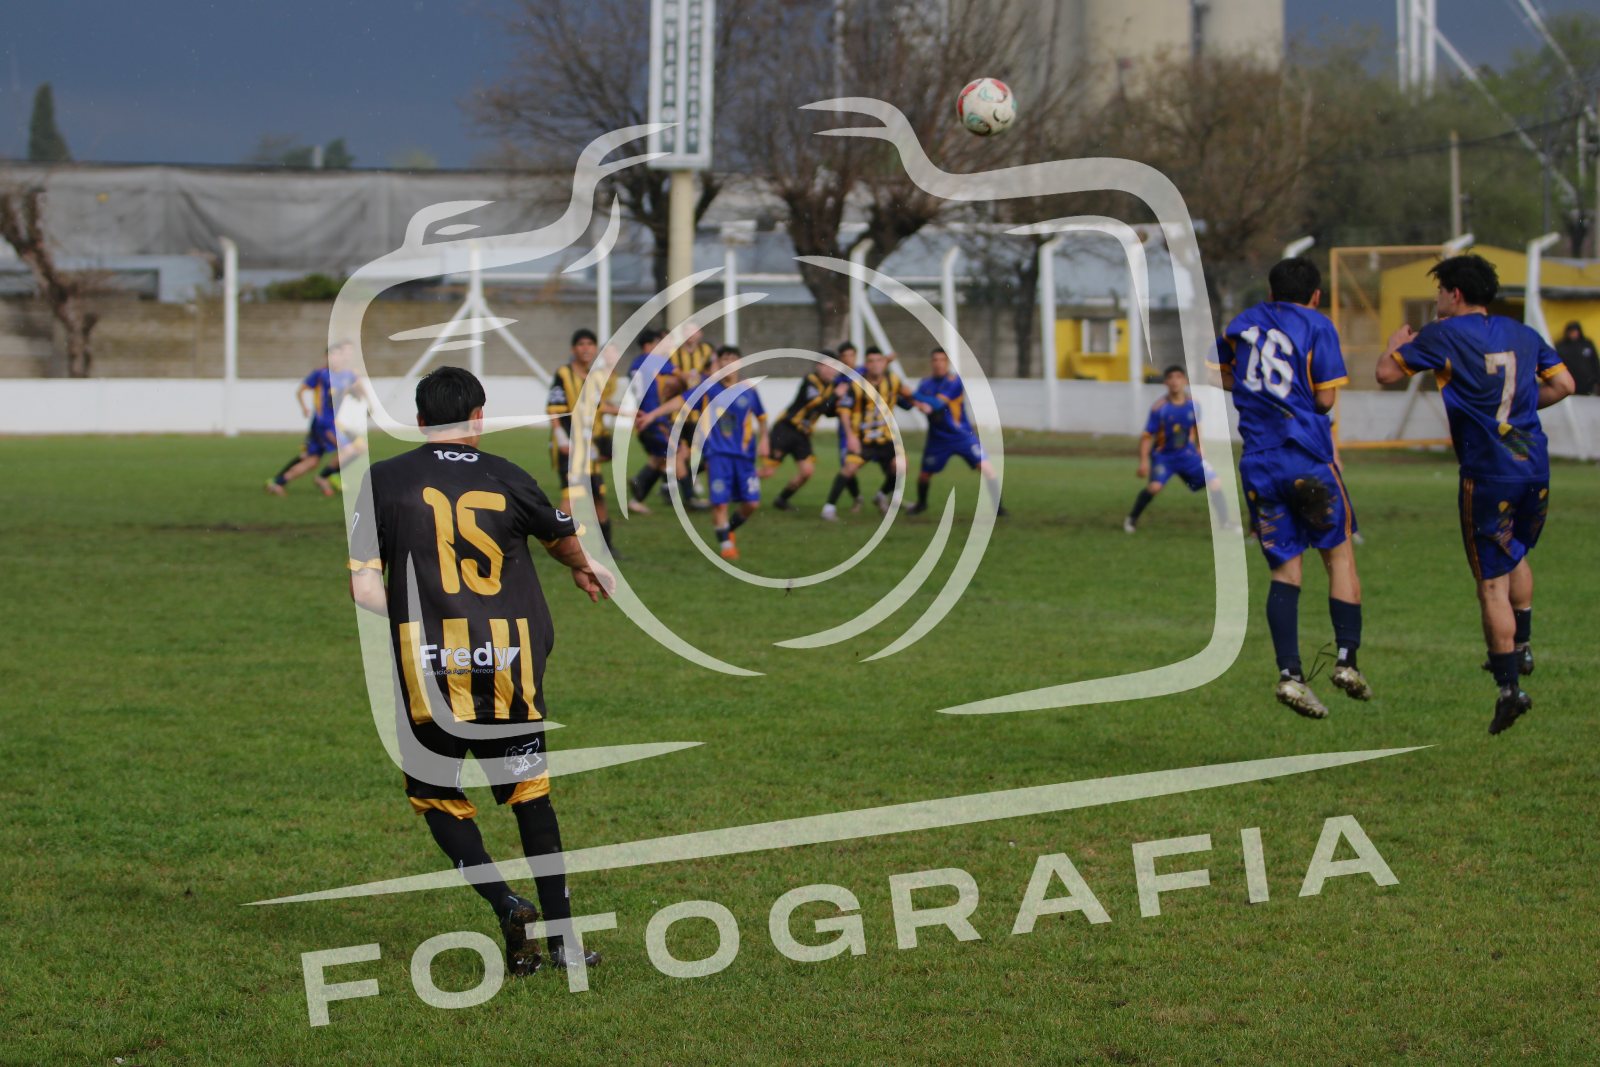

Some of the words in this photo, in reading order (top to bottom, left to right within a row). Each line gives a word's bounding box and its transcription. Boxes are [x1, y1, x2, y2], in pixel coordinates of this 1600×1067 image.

[1241, 326, 1293, 398] 16
[1484, 351, 1516, 423] 7
[423, 487, 506, 595] 15
[420, 642, 511, 671] Fredy
